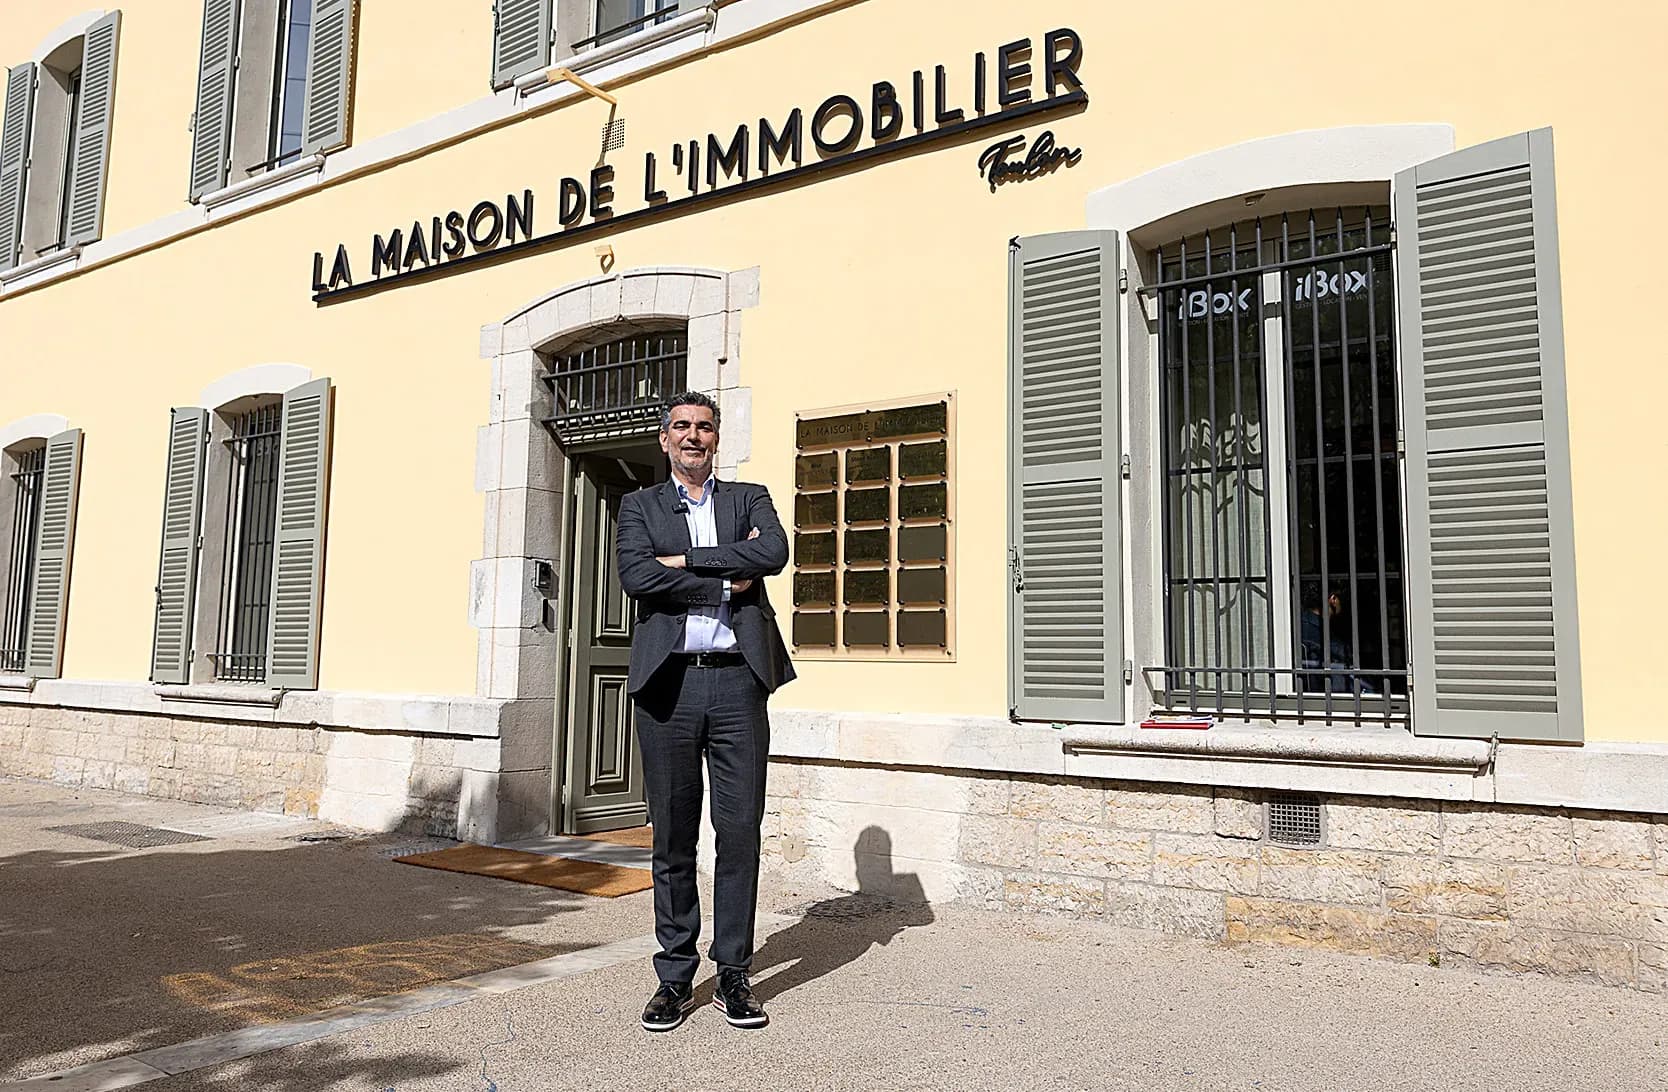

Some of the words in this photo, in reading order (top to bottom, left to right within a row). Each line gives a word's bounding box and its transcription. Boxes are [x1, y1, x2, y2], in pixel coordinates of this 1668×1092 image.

[312, 243, 352, 292] LA
[371, 188, 534, 277] MAISON
[558, 164, 615, 226] DE
[644, 27, 1085, 203] L'IMMOBILIER
[978, 130, 1083, 190] Toulon
[800, 428, 810, 438] LA
[816, 422, 853, 437] MAISON
[857, 421, 869, 432] DE
